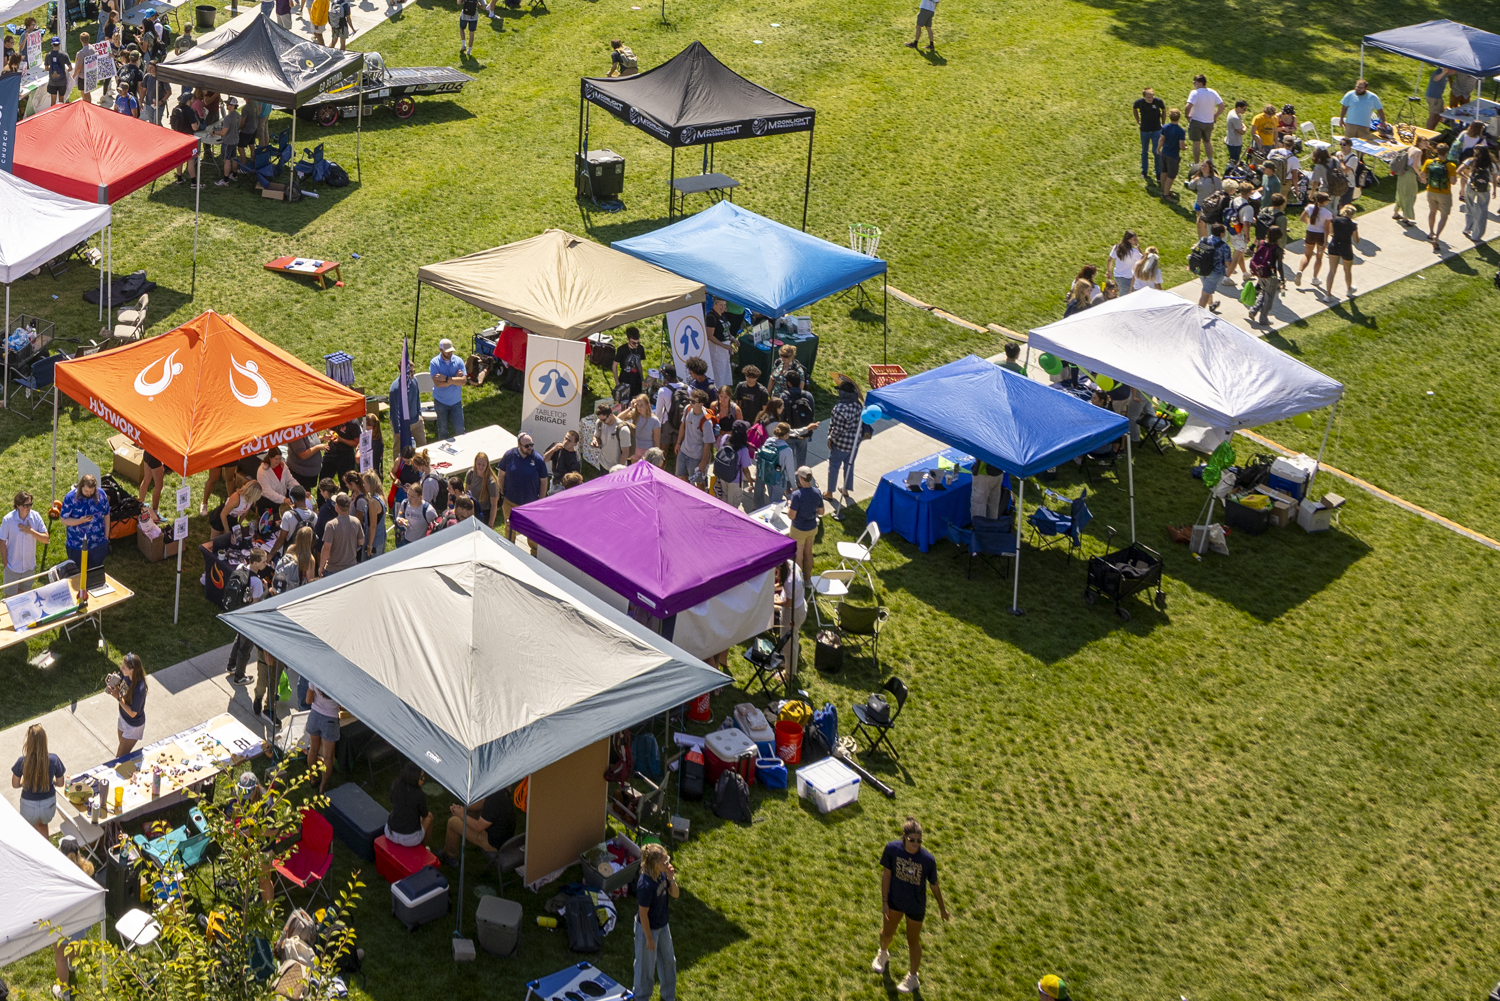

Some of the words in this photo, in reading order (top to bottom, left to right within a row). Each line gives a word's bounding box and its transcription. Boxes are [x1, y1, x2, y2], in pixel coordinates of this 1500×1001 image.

[437, 82, 464, 92] 406
[768, 116, 812, 130] MOONLIGHT
[696, 124, 743, 139] MOONLIGHT
[0, 130, 8, 164] CHURCH
[536, 408, 568, 417] TABLETOP
[89, 396, 144, 444] HOTWORX
[534, 414, 567, 426] BRIGADE
[240, 422, 315, 456] HOTWORX
